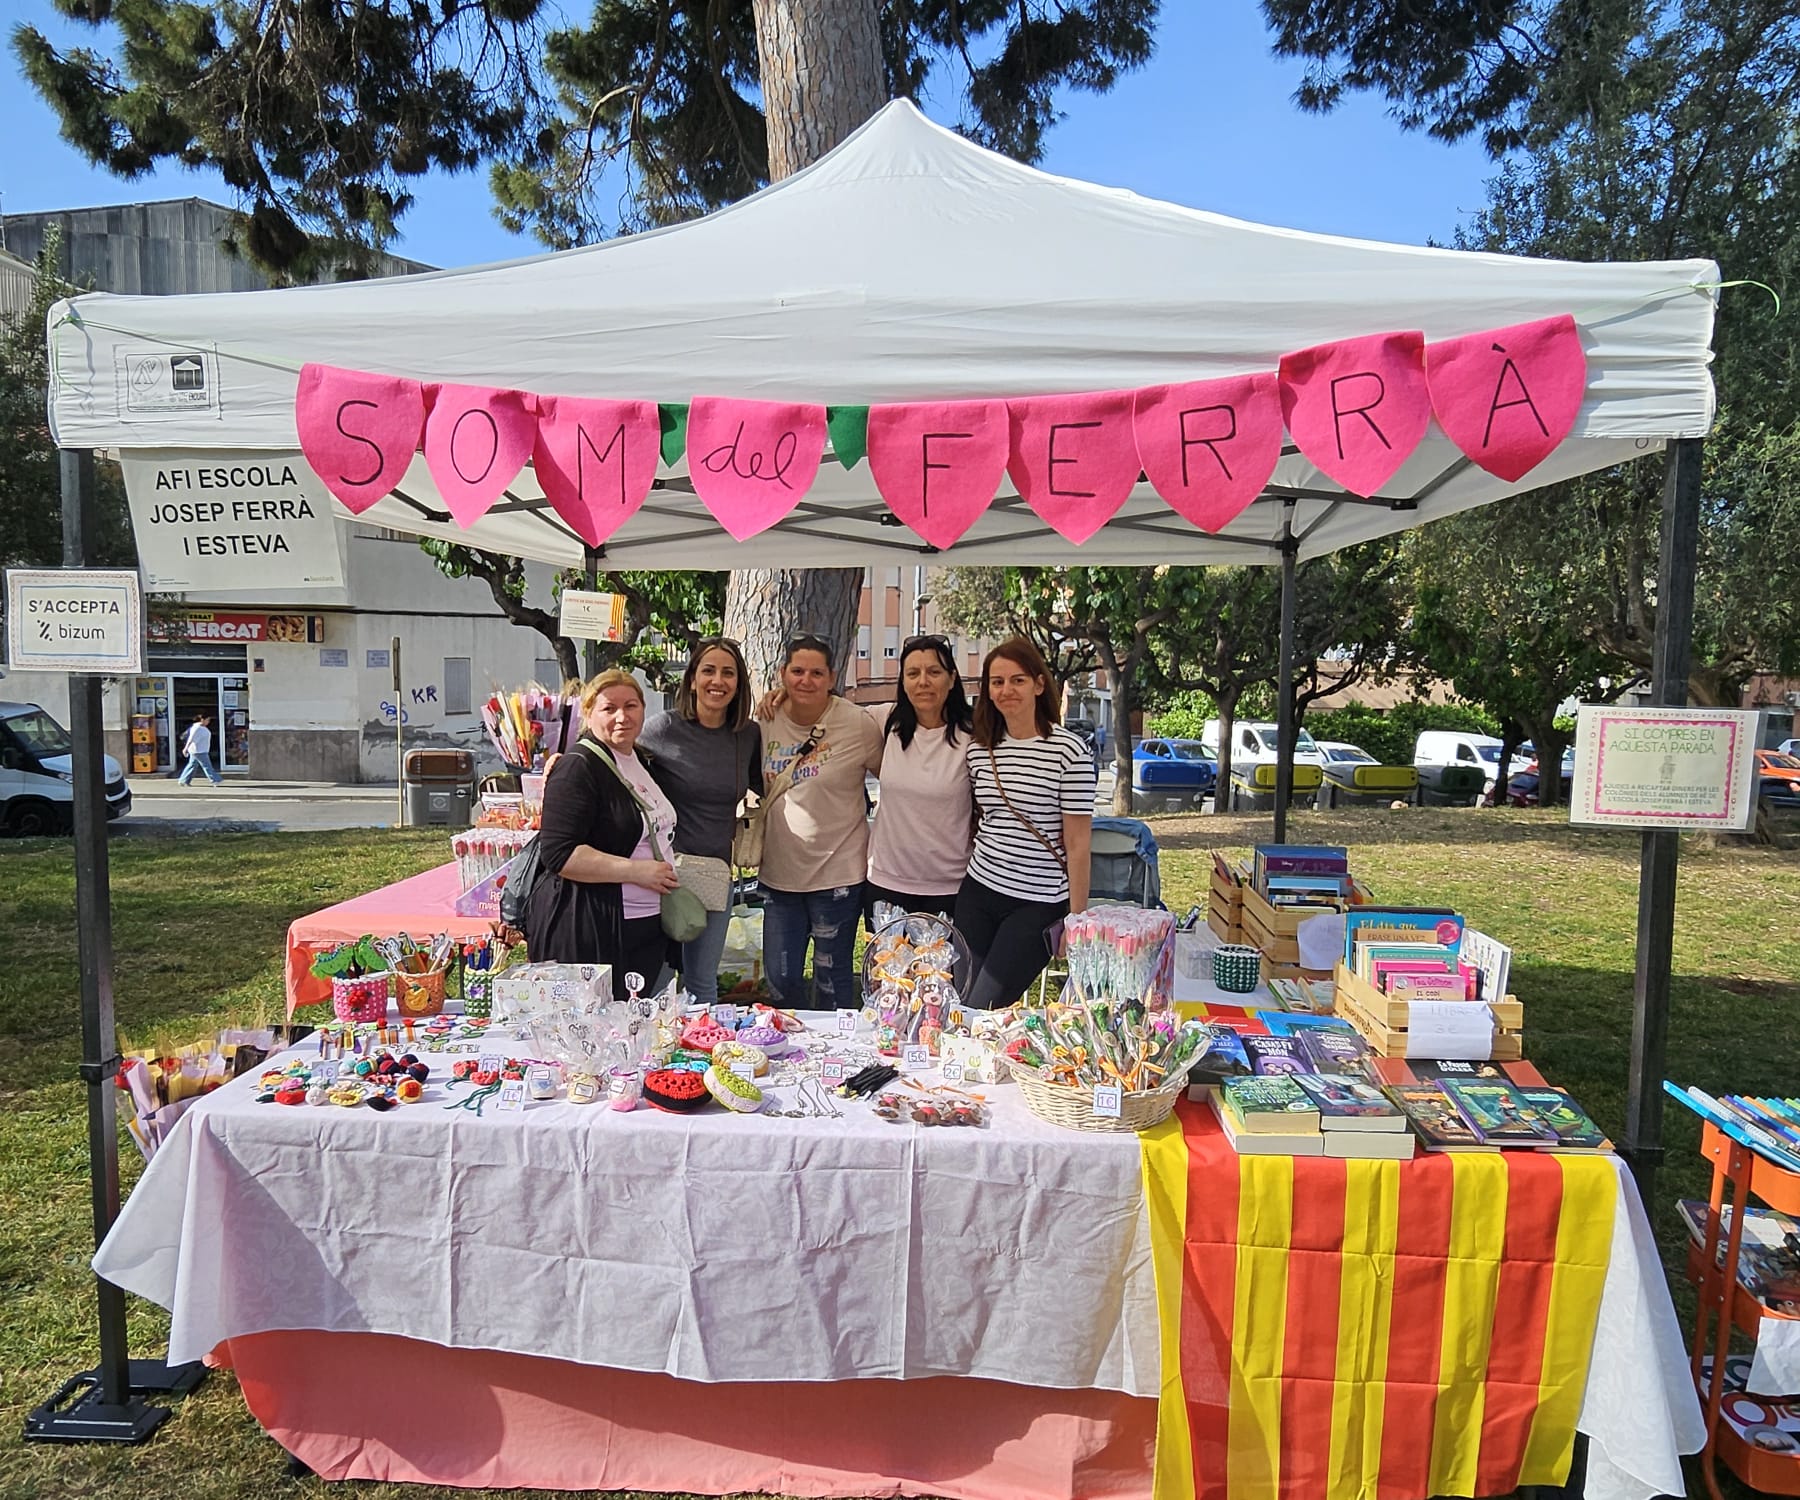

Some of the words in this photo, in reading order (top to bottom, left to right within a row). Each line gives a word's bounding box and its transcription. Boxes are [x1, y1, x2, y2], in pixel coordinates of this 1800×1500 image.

[336, 399, 627, 505] SOM
[701, 421, 796, 490] del
[923, 343, 1550, 518] FERRÀ
[156, 470, 191, 490] AFI
[198, 466, 297, 488] ESCOLA
[150, 502, 224, 524] JOSEP
[232, 494, 315, 521] FERRÀ
[183, 537, 190, 556] I
[197, 534, 290, 555] ESTEVA
[28, 600, 120, 614] S'ACCEPTA
[59, 623, 105, 640] bizum
[1643, 728, 1697, 741] COMPRES
[1700, 729, 1715, 741] EN
[1610, 740, 1668, 753] AQUESTA
[720, 1009, 732, 1019] 1€
[841, 1020, 852, 1028] 1€
[910, 1051, 925, 1061] 5€
[319, 1067, 334, 1078] 1€
[825, 1066, 840, 1076] 2€
[945, 1067, 959, 1078] 2€
[1100, 1096, 1115, 1107] 1€
